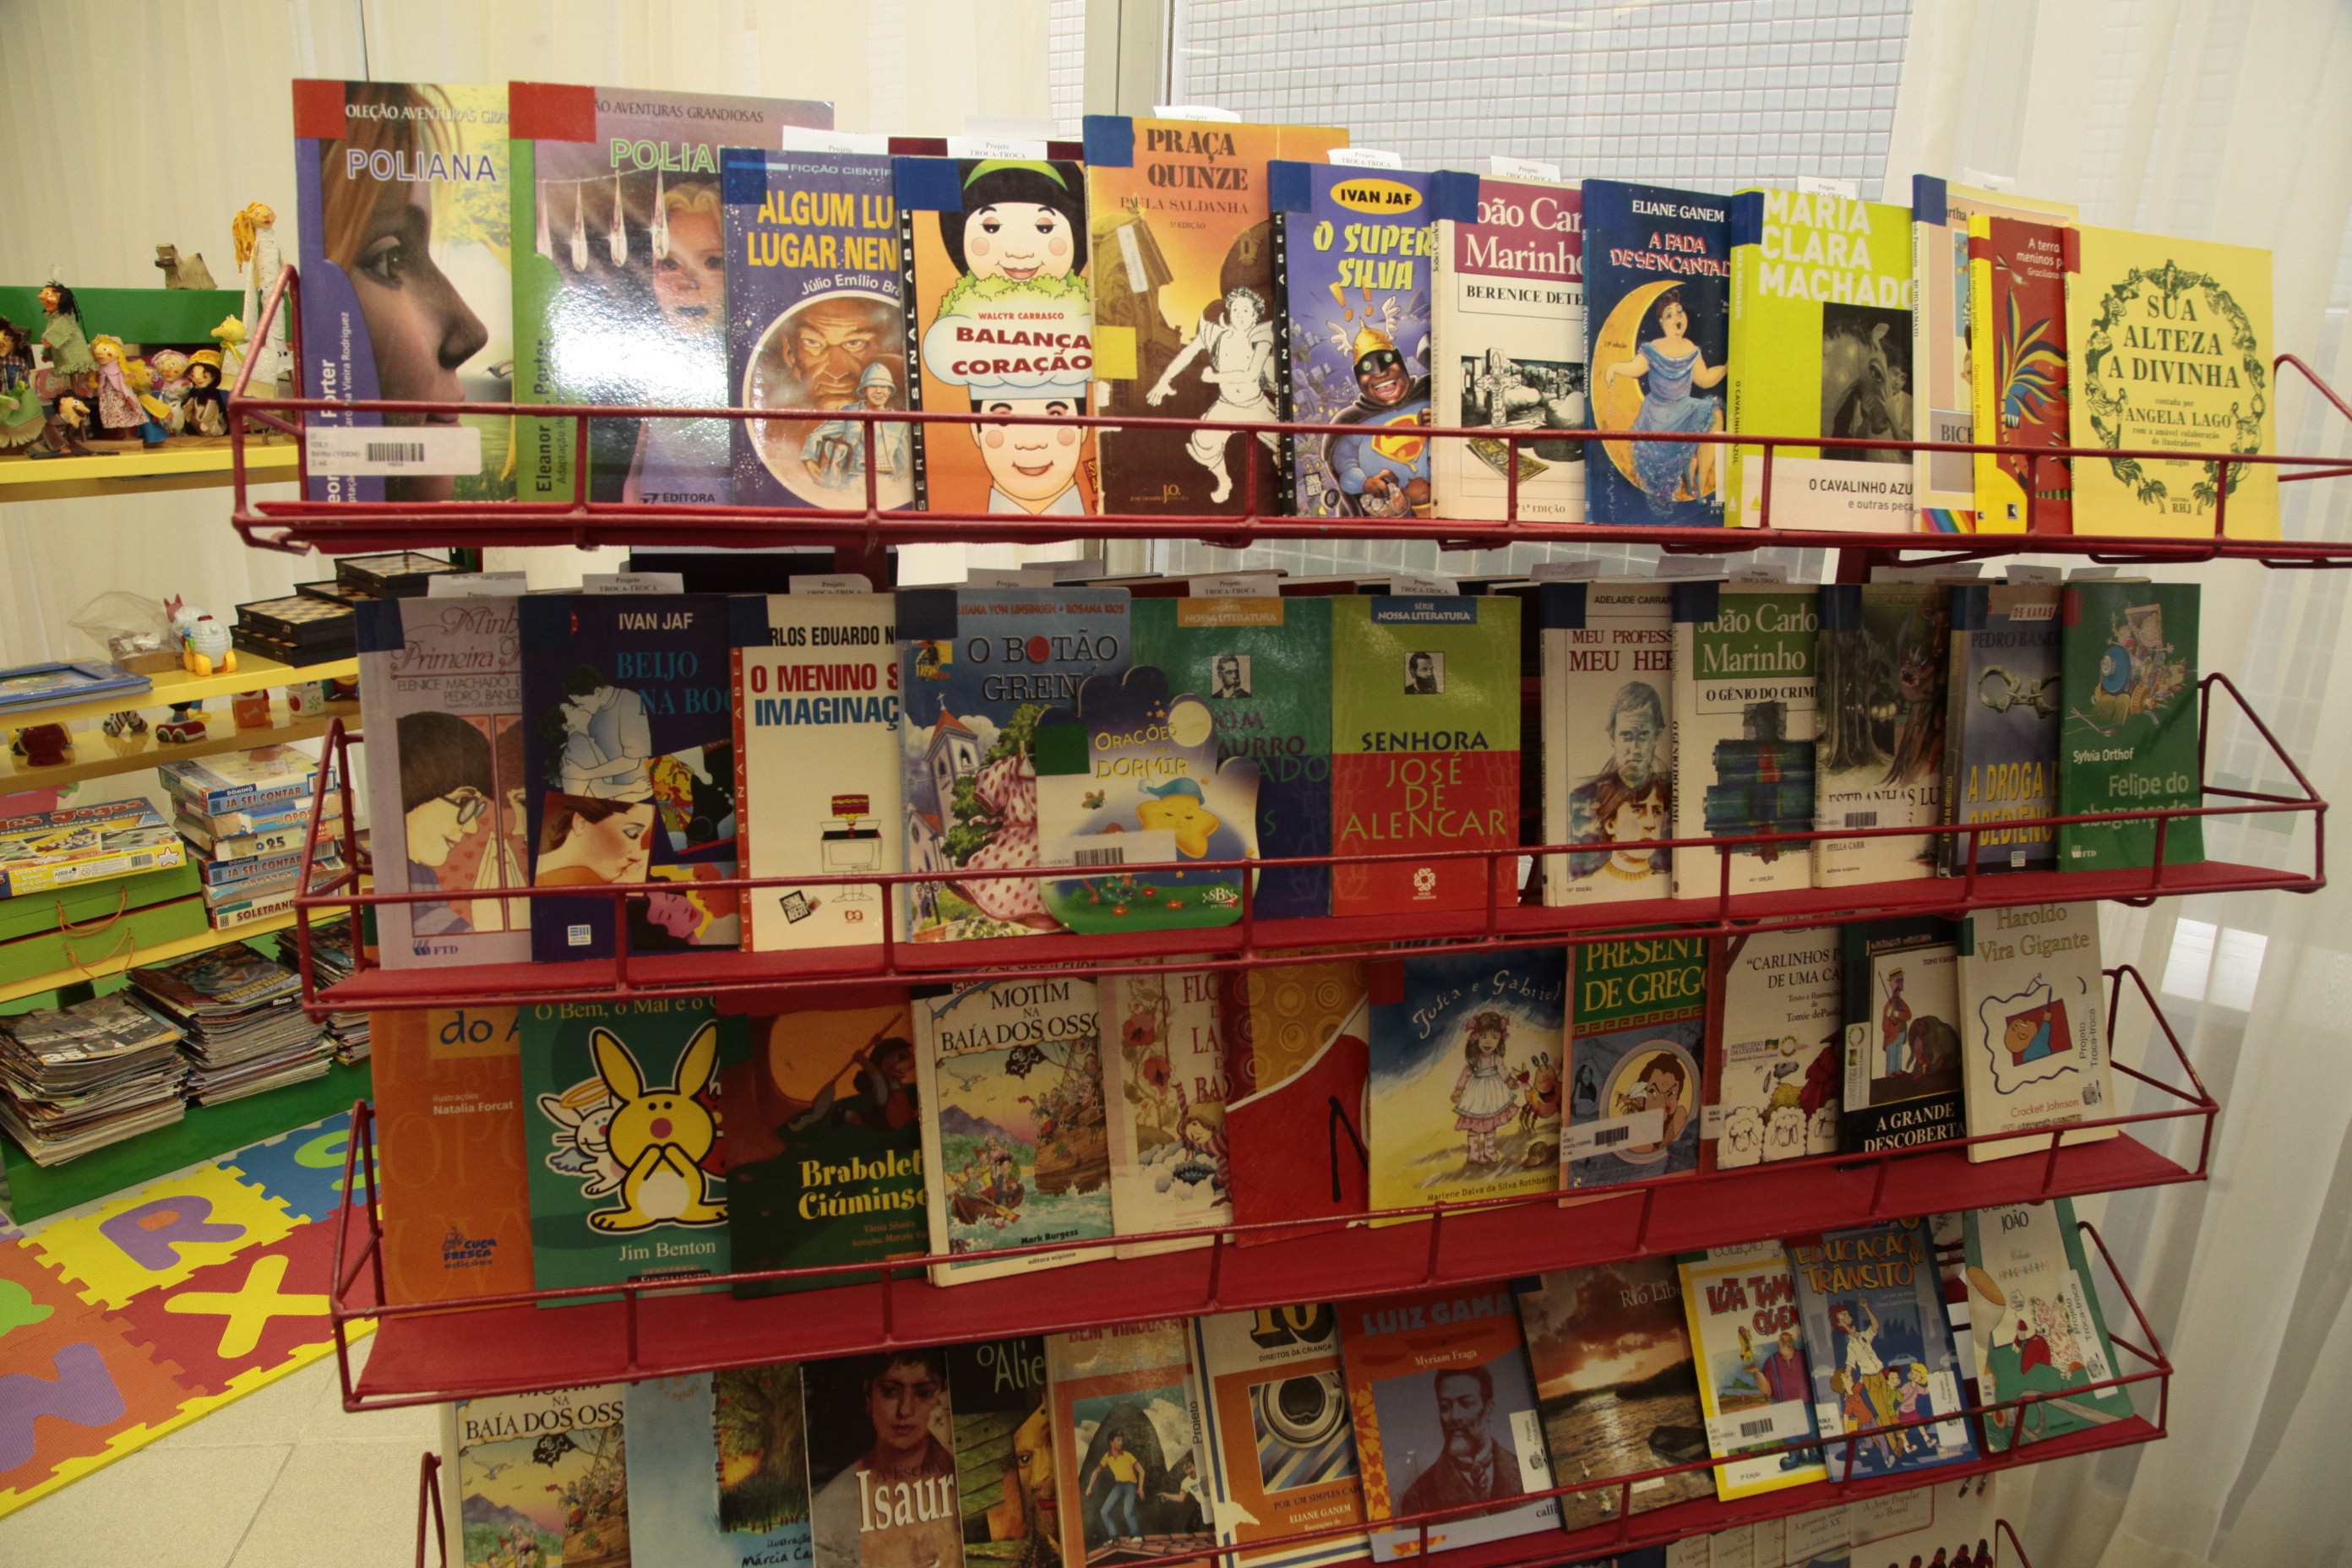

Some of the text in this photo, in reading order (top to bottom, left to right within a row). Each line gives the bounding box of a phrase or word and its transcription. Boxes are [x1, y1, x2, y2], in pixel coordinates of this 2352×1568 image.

[401, 106, 476, 122] AVENTURAS
[613, 101, 763, 122] AVENTURAS GRANDIOSAS
[970, 150, 1026, 159] TROCA-TROCA
[1146, 128, 1236, 161] PRAÇA
[346, 149, 496, 182] POLIANA
[791, 163, 838, 175] FICÇÃO
[1147, 164, 1248, 191] QUINZE
[1120, 196, 1249, 215] PAULA SALDANHA
[1340, 189, 1413, 205] IVAN JAF
[758, 190, 854, 228] ALGUM
[1632, 200, 1725, 223] ELIANE GANEM
[1763, 188, 1871, 235] MARIA
[1178, 221, 1206, 230] EDIÇÃO
[748, 232, 836, 267] LUGAR
[1313, 220, 1431, 258] O SUPER
[1648, 231, 1707, 253] A FADA
[1760, 226, 1872, 270] CLARA
[2028, 238, 2060, 253] A terra
[2017, 252, 2055, 266] meninos
[1337, 258, 1413, 291] SILVA
[2028, 267, 2059, 280] Graciliano
[802, 273, 879, 297] Júlio Emílio
[1467, 286, 1542, 302] BERENICE
[978, 312, 1064, 321] WALCYR CARRASCO
[2148, 295, 2197, 321] SUA
[341, 312, 351, 360] Rodriguez
[956, 326, 1091, 353] BALANÇA
[2123, 327, 2224, 356] ALTEZA
[906, 307, 918, 400] SINAL
[1279, 308, 1290, 395] SINAL
[951, 349, 1092, 377] CORAÇÃO
[2109, 358, 2240, 389] A DIVINHA
[2126, 407, 2232, 428] ANGELA LAGO
[536, 425, 552, 492] Eleanor
[1809, 479, 1887, 494] O CAVALINHO
[662, 493, 716, 504] EDITORA
[1857, 499, 1890, 510] outras
[2172, 503, 2191, 514] RHJ
[1532, 505, 1565, 514] EDIÇÃO
[1414, 602, 1435, 611] SÉRIE
[1593, 596, 1635, 605] ADELAIDE
[618, 612, 694, 630] IVAN JAF
[1378, 611, 1472, 621] NOSSA LITERATURA
[2028, 607, 2055, 618] KARAS
[812, 625, 879, 645] EDUARDO
[1572, 630, 1605, 645] MEU
[1971, 633, 2014, 648] PEDRO
[968, 635, 991, 663] O
[1702, 641, 1806, 673] Marinho
[616, 651, 698, 680] BEIJO
[1569, 651, 1620, 672] MEU
[446, 677, 509, 689] MACHADO
[750, 662, 877, 694] O MENINO
[1706, 686, 1778, 702] O GÊNIO DO
[1361, 731, 1489, 752] SENHORA
[2073, 748, 2134, 765] Sylvia Orthof
[1097, 757, 1189, 779] DORMIR
[1386, 752, 1463, 788] JOSÉ
[227, 786, 253, 796] DOMINÓ
[1968, 761, 2044, 803] A DROGA
[2108, 773, 2189, 799] Felipe do
[226, 796, 237, 808] JÁ
[260, 787, 302, 801] CONTAR
[1404, 784, 1446, 813] DE
[50, 800, 144, 822] Jogos
[1341, 809, 1506, 841] ALENCAR
[266, 836, 286, 850] 25
[227, 864, 258, 879] JÁ SEI
[1995, 904, 2067, 932] Haroldo
[433, 945, 459, 956] FTD
[1978, 932, 2090, 963] Vira Gigante
[1767, 971, 1819, 989] DE UMA
[633, 999, 669, 1014] Mal
[991, 982, 1070, 1010] MOTIM
[1584, 980, 1622, 1013] DE
[1023, 1008, 1040, 1018] NA
[1786, 1012, 1810, 1021] Tomie
[439, 1010, 493, 1044] do
[941, 1019, 1043, 1052] BAÍA DOS
[2089, 1007, 2099, 1068] Troca-troca
[2078, 1021, 2088, 1060] Projeto
[433, 1100, 514, 1115] Natalia Forcat
[1876, 1102, 1955, 1132] A GRANDE
[2011, 1099, 2080, 1119] Crockett Johnson
[1427, 1174, 1558, 1202] Marlene Dalva da Silva Rothbarth
[2001, 1211, 2028, 1234] JOÃO
[1021, 1228, 1079, 1245] Mark Burgess
[619, 1242, 716, 1262] Jim Benton
[1795, 1233, 1916, 1266] EDUCAÇÃO
[1028, 1256, 1049, 1266] editora
[1802, 1263, 1914, 1295] TRÂNSITO
[1620, 1289, 1648, 1309] Rio
[1362, 1293, 1516, 1337] LUIZ GAMA
[2067, 1297, 2081, 1336] Projeto
[1259, 1342, 1332, 1363] DIREITOS DA CRIANÇA
[1414, 1348, 1478, 1368] Myriam Fraga
[552, 1396, 569, 1407] NA
[466, 1407, 572, 1440] BAÍA DOS
[1192, 1401, 1204, 1445] Projeto
[1273, 1490, 1340, 1510] POR UM SIMPLES
[1289, 1504, 1351, 1524] ELIANE GANEM
